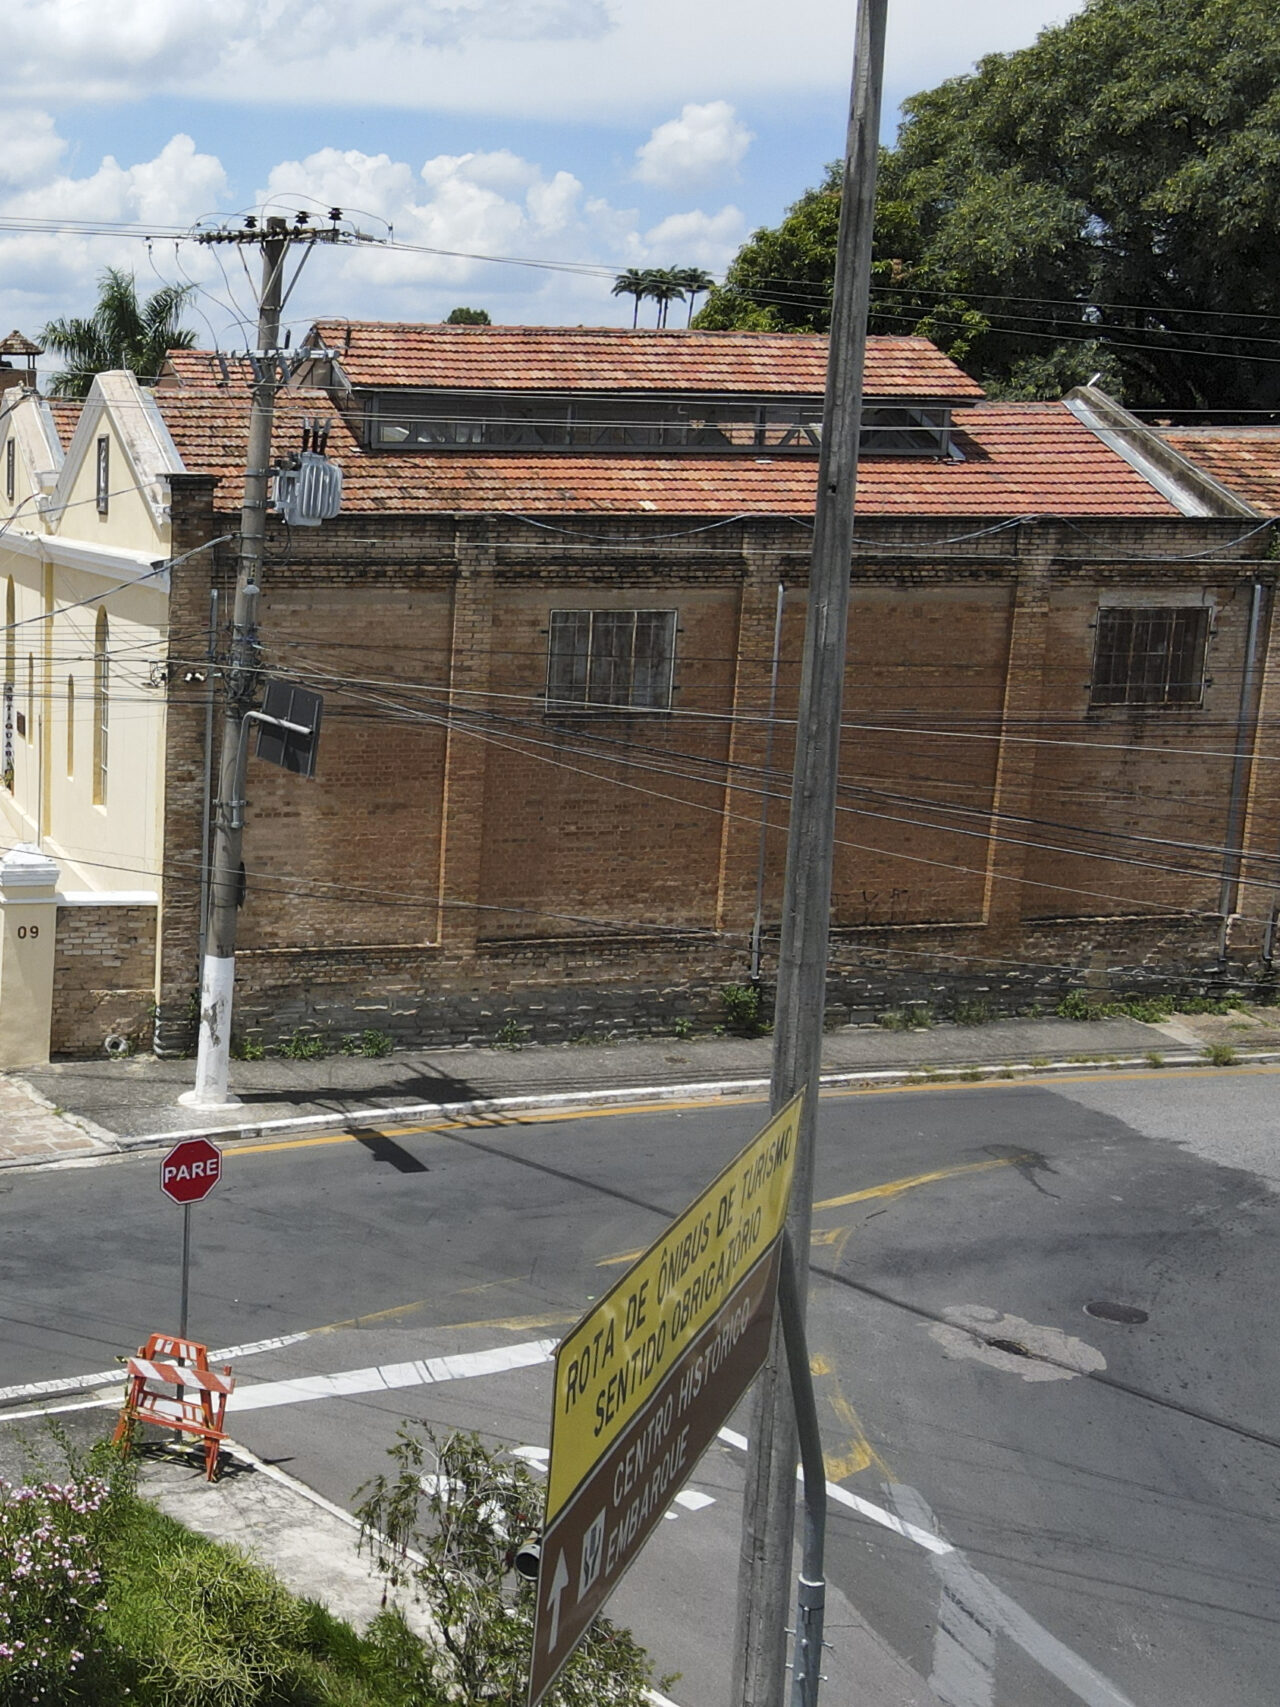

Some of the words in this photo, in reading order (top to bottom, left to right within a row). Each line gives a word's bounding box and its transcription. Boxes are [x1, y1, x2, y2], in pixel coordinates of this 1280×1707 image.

[17, 925, 39, 940] 09
[164, 1158, 218, 1184] PARE
[565, 1317, 614, 1415] ROTA
[624, 1280, 649, 1343] DE
[657, 1211, 712, 1307] ÔNIBUS
[715, 1185, 736, 1238] DE
[740, 1125, 793, 1210] TURISMO
[593, 1320, 666, 1438] SENTIDO
[671, 1205, 762, 1343] OBRIGATÓRIO
[605, 1424, 690, 1578] EMBARQUE
[613, 1394, 674, 1507] CENTRO
